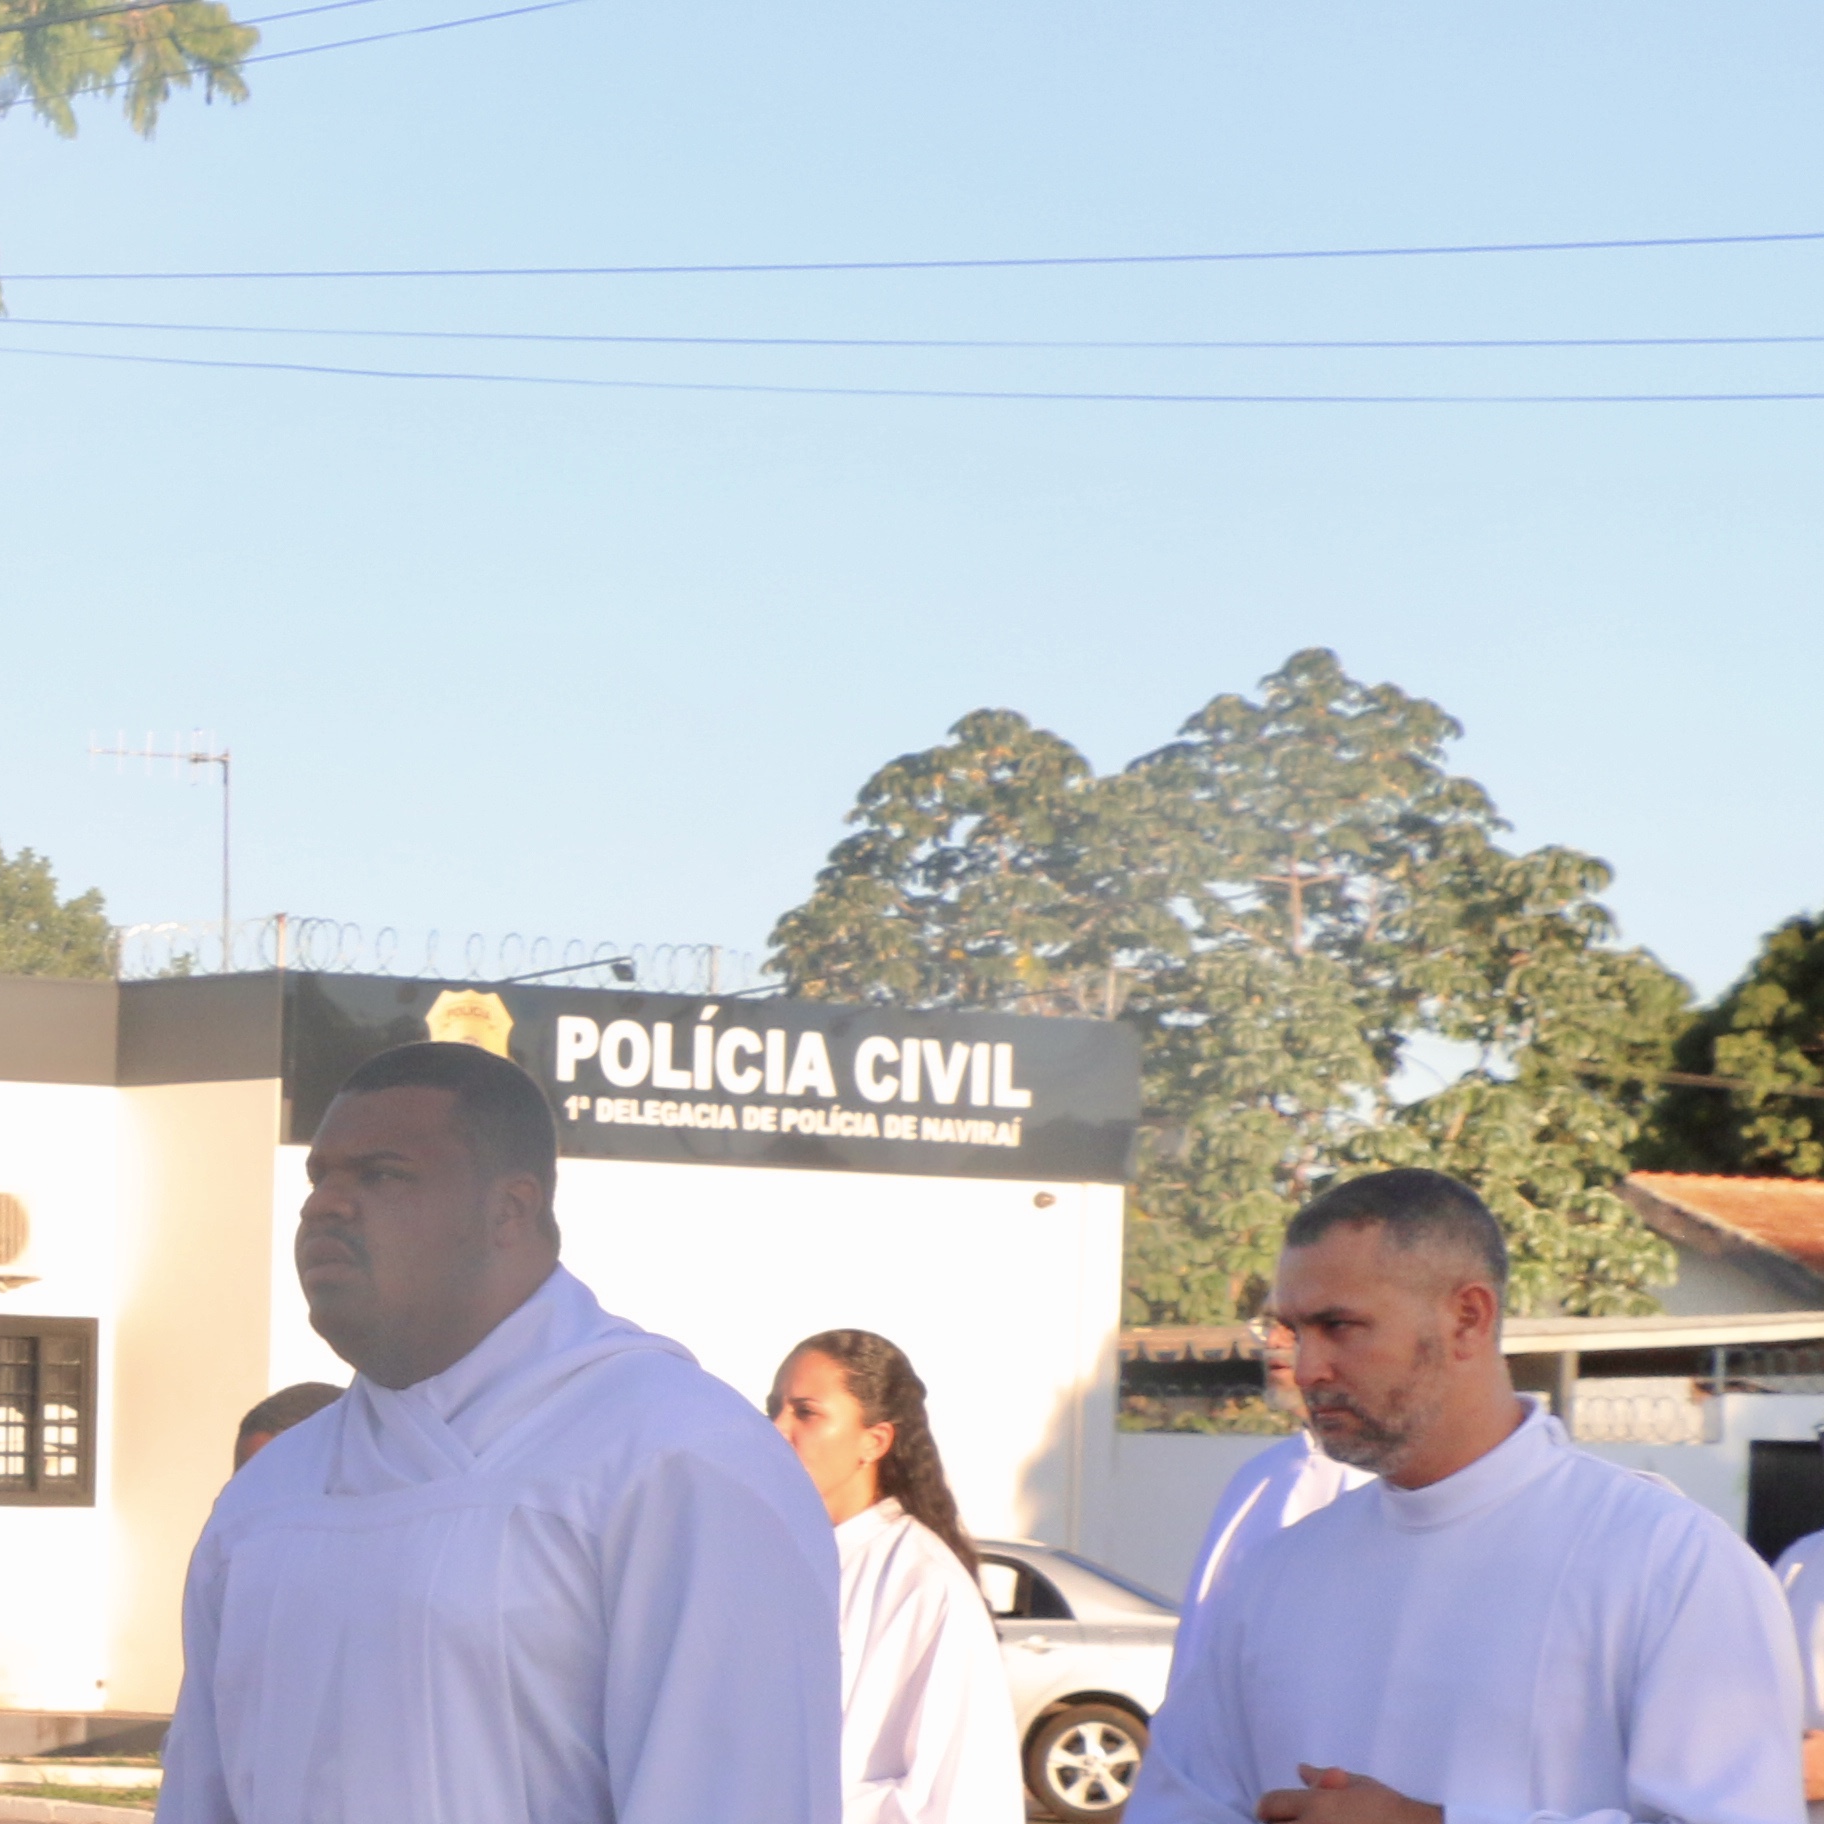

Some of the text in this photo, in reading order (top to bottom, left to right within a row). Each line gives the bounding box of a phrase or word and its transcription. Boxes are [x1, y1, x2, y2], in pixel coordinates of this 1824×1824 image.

[556, 1004, 1032, 1108] POLÍCIA CIVIL
[595, 1097, 738, 1130] DELEGACIA
[742, 1105, 778, 1132] DE
[781, 1104, 880, 1138] POLÍCIA
[882, 1114, 918, 1139] DE
[921, 1117, 1022, 1147] NAVIRAÍ
